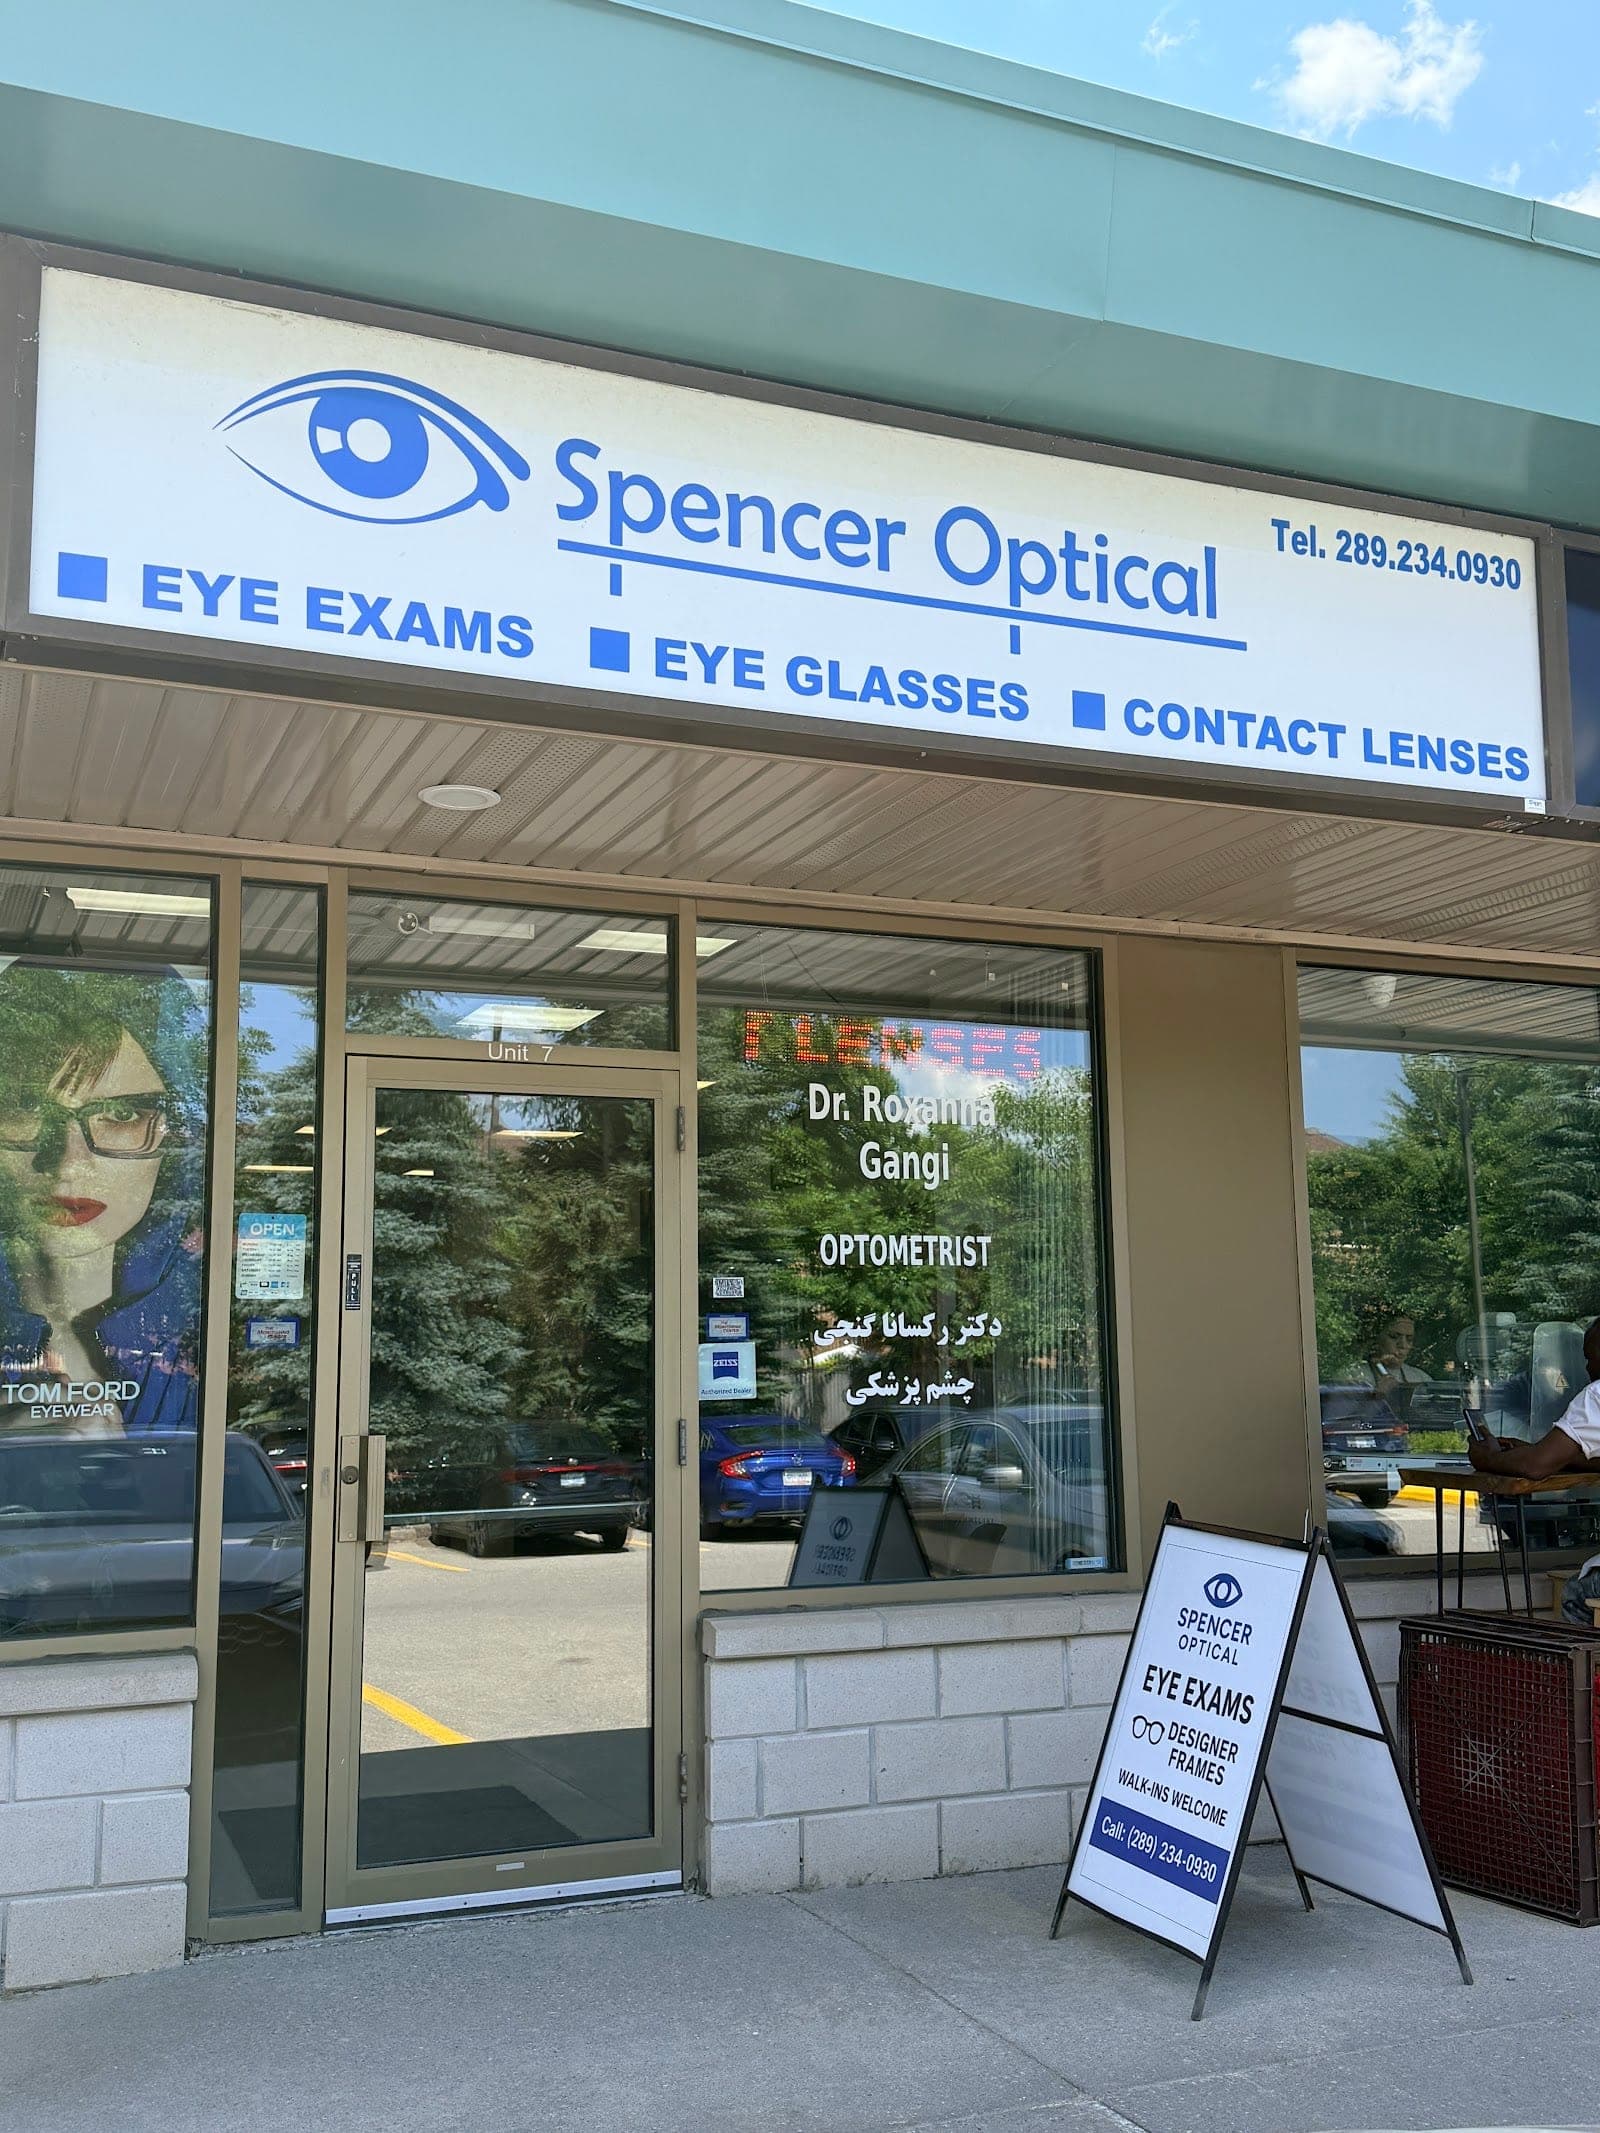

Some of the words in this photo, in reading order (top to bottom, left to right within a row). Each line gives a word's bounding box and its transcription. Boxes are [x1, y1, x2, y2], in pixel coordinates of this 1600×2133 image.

[555, 438, 907, 573] Spencer
[934, 505, 1218, 621] Optical
[1271, 519, 1326, 558] Tel.
[1335, 530, 1522, 591] 289.234.0930
[142, 563, 280, 625] EYE
[306, 586, 534, 659] EXAMS
[655, 637, 765, 691] EYE
[785, 655, 1030, 722] GLASSES
[1123, 698, 1347, 759] CONTACT
[1362, 727, 1530, 782] LENSES
[487, 1043, 529, 1062] Unit
[541, 1046, 554, 1063] 7
[795, 1013, 1042, 1080] LENSES
[808, 1082, 850, 1121] Dr.
[863, 1085, 996, 1127] Roxanna
[859, 1140, 950, 1191] Gangi
[250, 1222, 296, 1237] OPEN
[819, 1233, 992, 1267] OPTOMETRIST
[350, 1272, 358, 1302] PULL
[813, 1311, 877, 1347] گنجی
[954, 1311, 1003, 1346] دکتر
[713, 1358, 738, 1367] ZEISS
[1, 1382, 61, 1404] TOM
[67, 1380, 141, 1402] FORD
[733, 1386, 752, 1394] Dealer
[845, 1370, 921, 1406] پزشکی
[926, 1369, 976, 1405] چشم
[30, 1404, 115, 1419] EYEWEAR
[1177, 1606, 1253, 1646] SPENCER
[1178, 1634, 1239, 1666] OPTICAL
[1142, 1663, 1182, 1701] EYE
[1182, 1676, 1255, 1725] EXAMS
[1167, 1721, 1239, 1764] DESIGNER
[1167, 1747, 1226, 1786] FRAMES
[1118, 1767, 1170, 1803] WALK-INS
[1171, 1789, 1229, 1827] WELCOME
[1101, 1815, 1126, 1842] Call:
[1127, 1824, 1158, 1859] (289)
[1158, 1841, 1217, 1883] 234-0930
